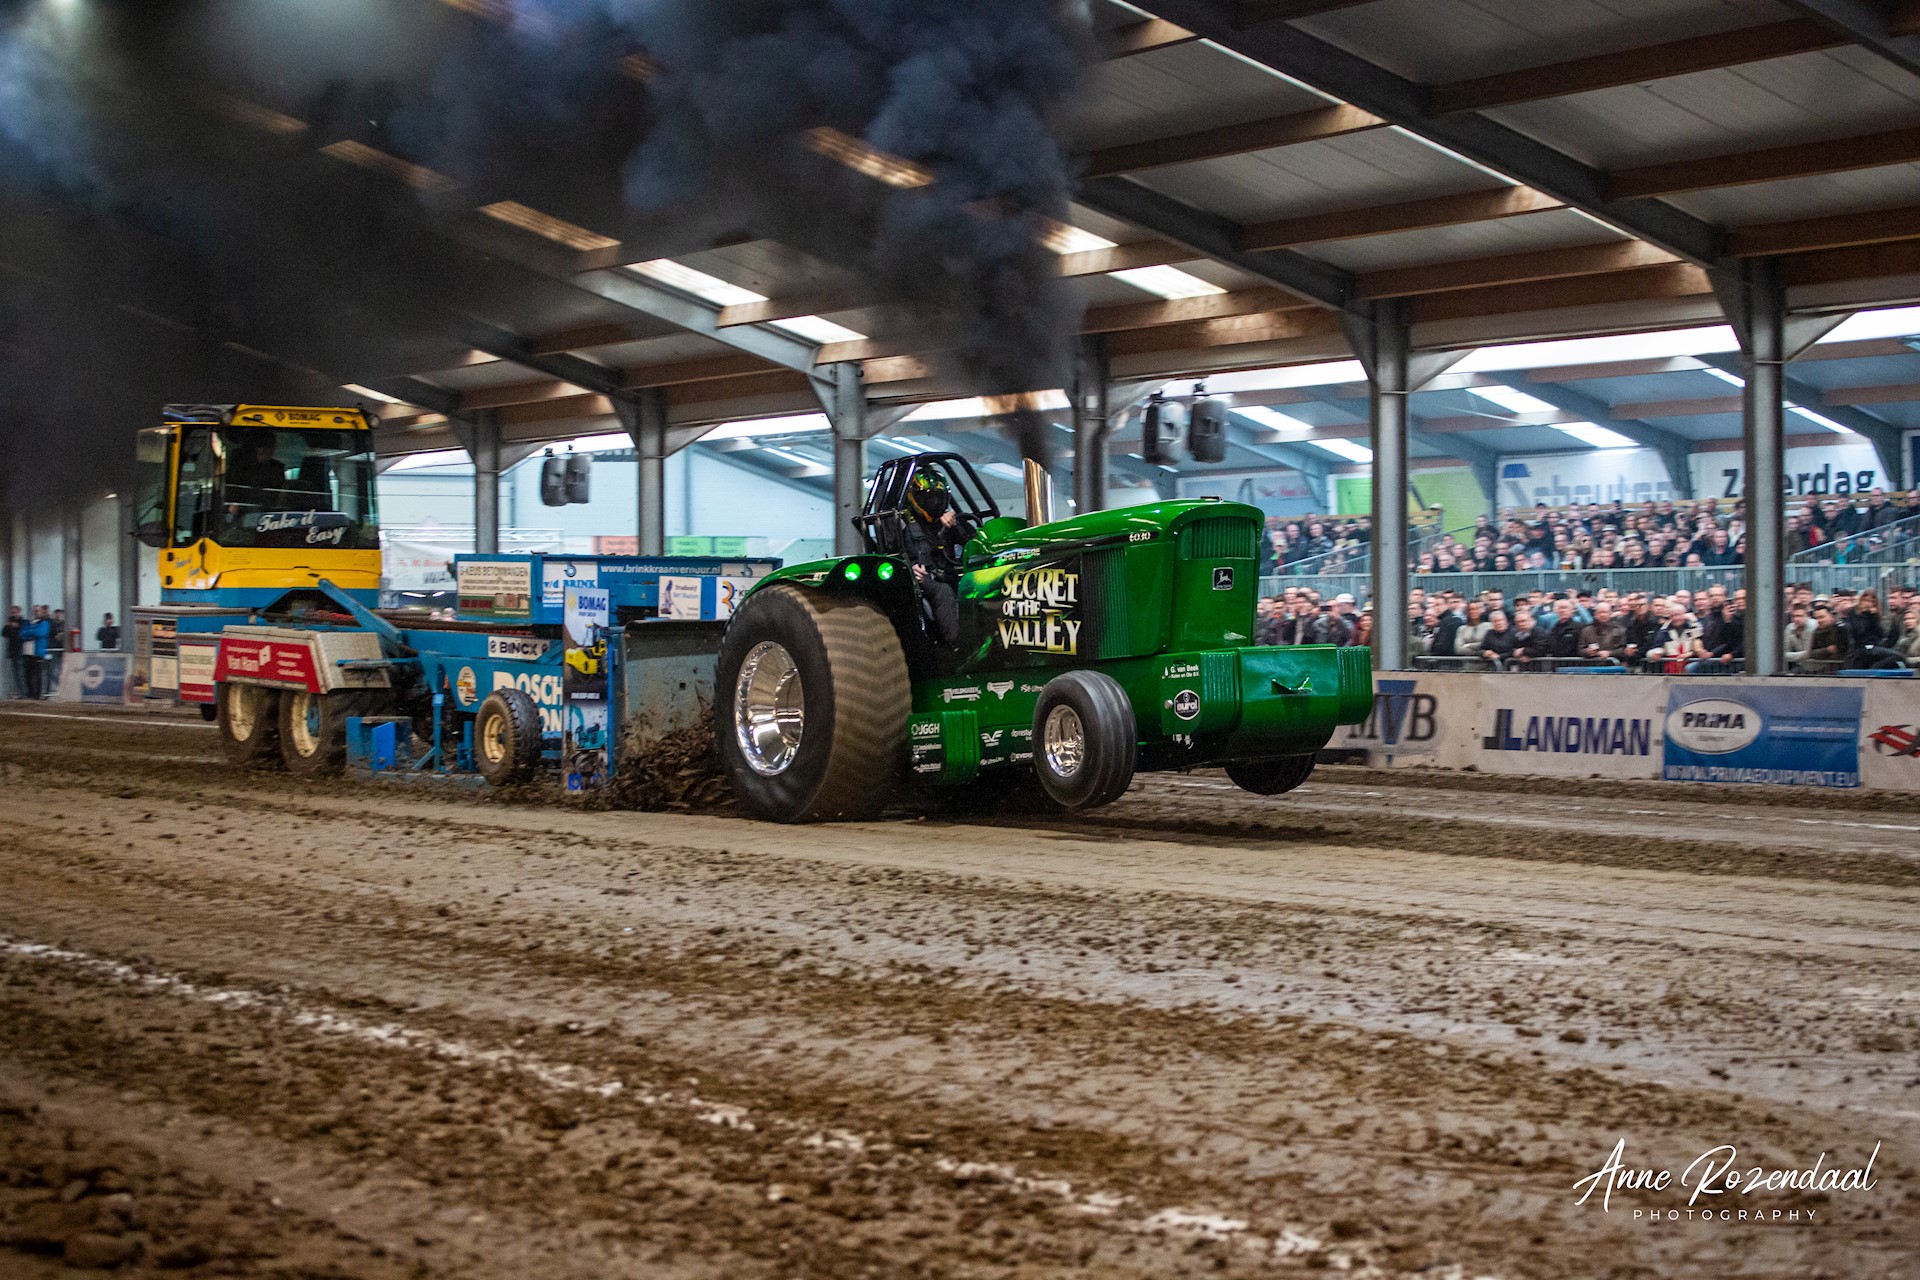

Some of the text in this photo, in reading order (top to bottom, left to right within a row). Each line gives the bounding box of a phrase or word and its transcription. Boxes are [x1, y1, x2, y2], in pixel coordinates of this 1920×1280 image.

[1723, 463, 1876, 498] Zerdag
[256, 508, 316, 532] Take it
[305, 526, 347, 544] Easy
[1129, 531, 1151, 542] 6030
[563, 580, 596, 589] BRINK
[1001, 568, 1079, 608] SECRET
[578, 596, 606, 611] BOMAG
[1003, 600, 1041, 618] OF THE
[998, 608, 1082, 655] VALLEY
[1176, 700, 1198, 711] eurol
